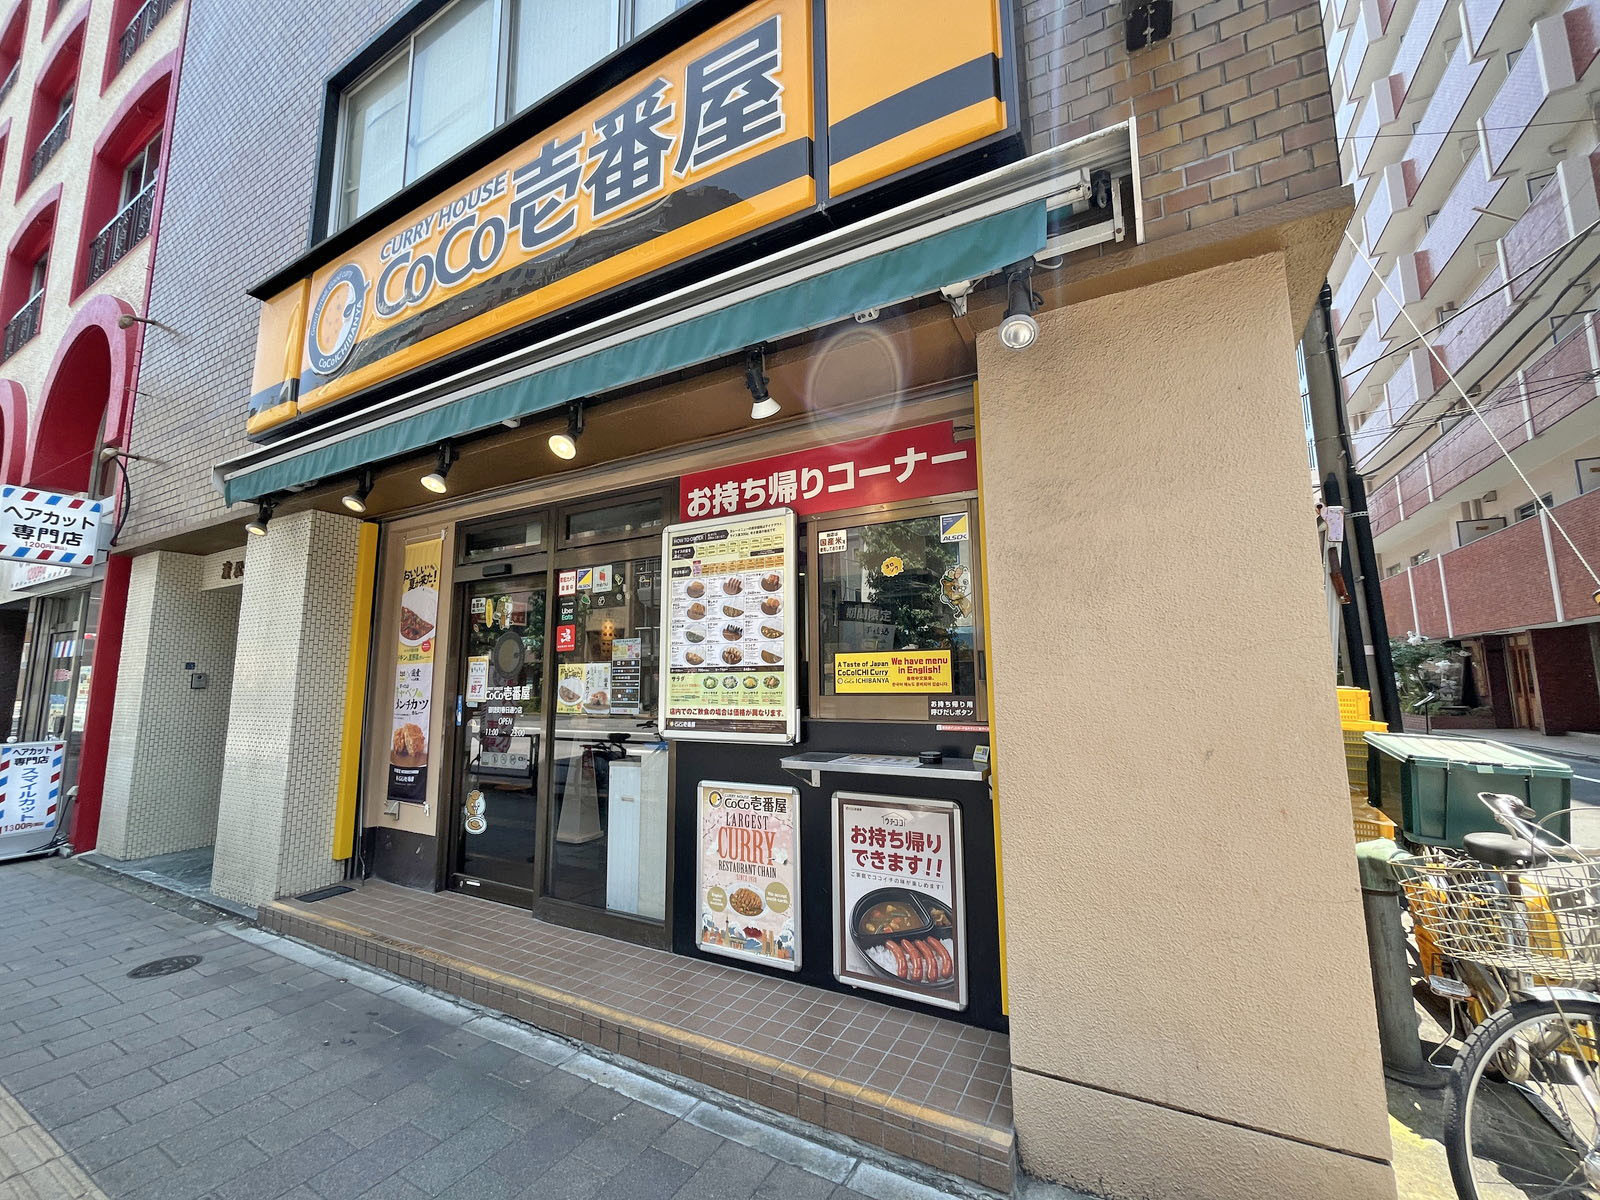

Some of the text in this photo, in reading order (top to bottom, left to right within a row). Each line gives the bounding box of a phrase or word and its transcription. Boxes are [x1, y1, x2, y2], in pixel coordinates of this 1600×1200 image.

[375, 15, 785, 318] CoCo壱番屋
[380, 169, 510, 262] CURRY HOUSE
[686, 447, 968, 518] お持ち帰りコーナー
[3, 505, 96, 530] ヘアカット
[11, 523, 84, 547] 専門店
[942, 534, 967, 542] ALSOK
[845, 606, 893, 622] 期間限定
[862, 660, 869, 668] of
[869, 660, 889, 668] Japan
[891, 656, 948, 665] We have menu
[837, 668, 889, 677] CoCoICHI Curry
[897, 665, 941, 675] in English!
[484, 685, 531, 701] CoCo壱番屋
[930, 700, 974, 708] お持ち帰り用
[930, 708, 974, 716] 呼びだしボタン
[497, 717, 513, 726] OPEN
[484, 728, 499, 737] 11:00
[12, 746, 53, 756] ヘアカット
[14, 755, 50, 767] 専門店
[18, 767, 39, 822] スマイルカット
[724, 796, 787, 814] CoCo壱番屋
[726, 812, 769, 830] LARGEST
[884, 818, 904, 827] ウチココ
[717, 826, 776, 866] CURRY
[850, 825, 942, 854] お持ち帰り
[718, 860, 777, 879] RESTAURANT CHAIN
[851, 849, 943, 878] できます!!
